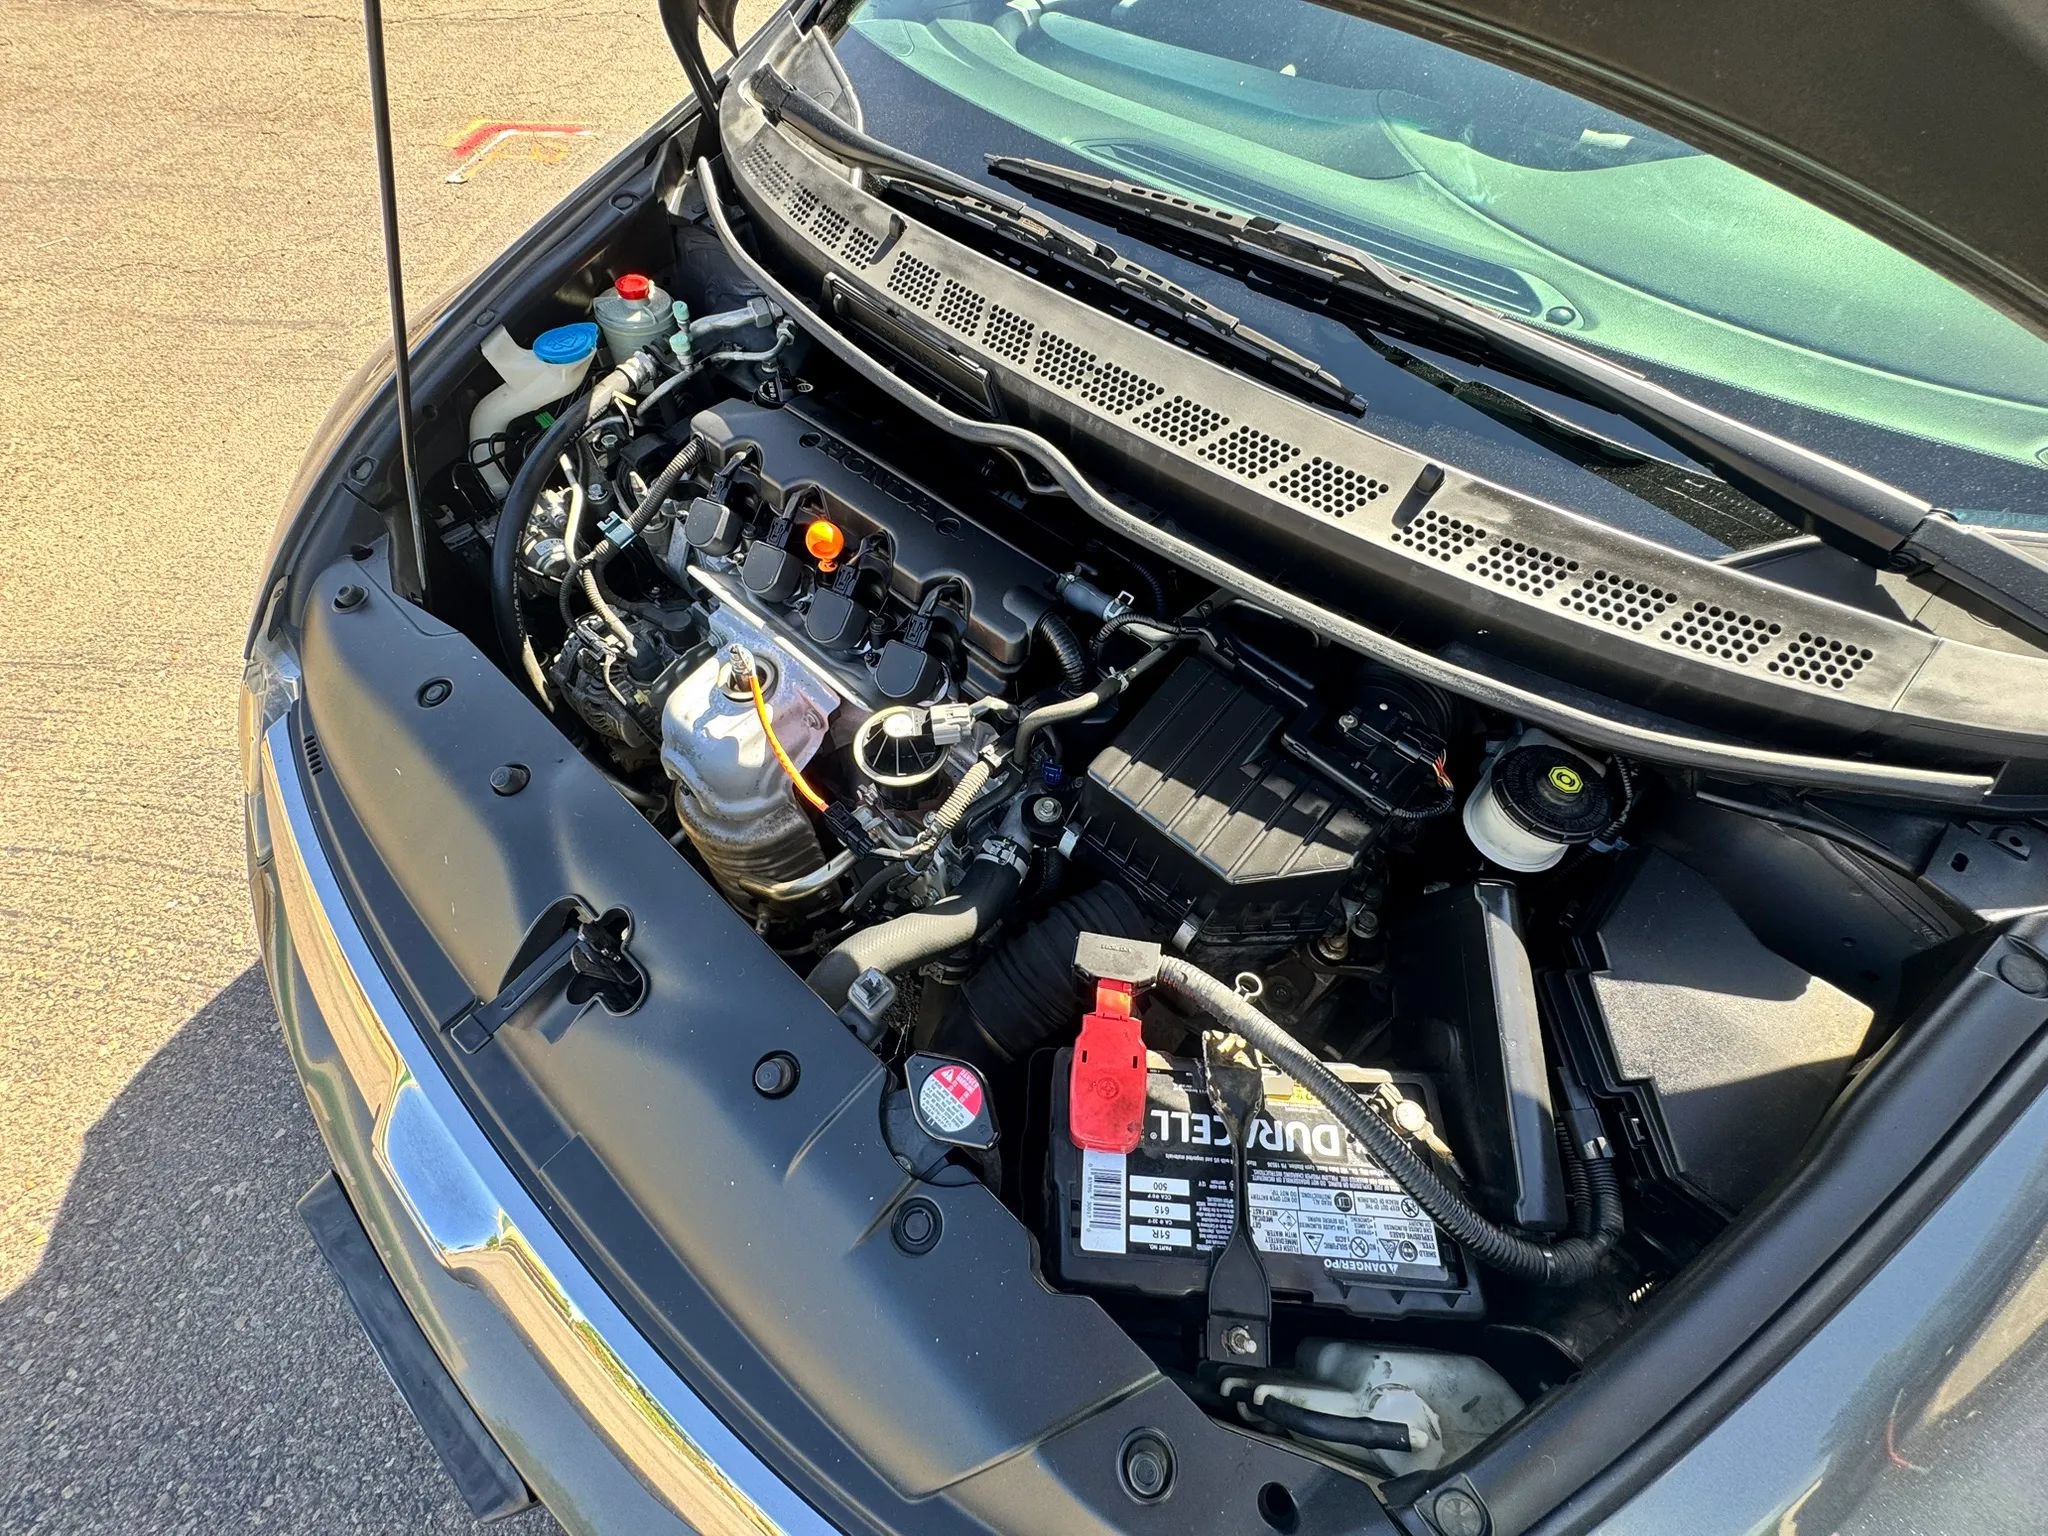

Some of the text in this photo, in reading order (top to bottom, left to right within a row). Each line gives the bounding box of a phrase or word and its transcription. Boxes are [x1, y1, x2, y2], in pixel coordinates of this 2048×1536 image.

[816, 436, 937, 523] HONDA
[1153, 1182, 1168, 1192] 500
[1154, 1205, 1170, 1215] 615
[1152, 1229, 1170, 1240] 51R
[1285, 1231, 1298, 1239] WITH
[1389, 1231, 1434, 1241] EXPLOSIVE GASES
[1265, 1237, 1298, 1246] IMMEDIATELY
[1158, 1244, 1172, 1252] PART
